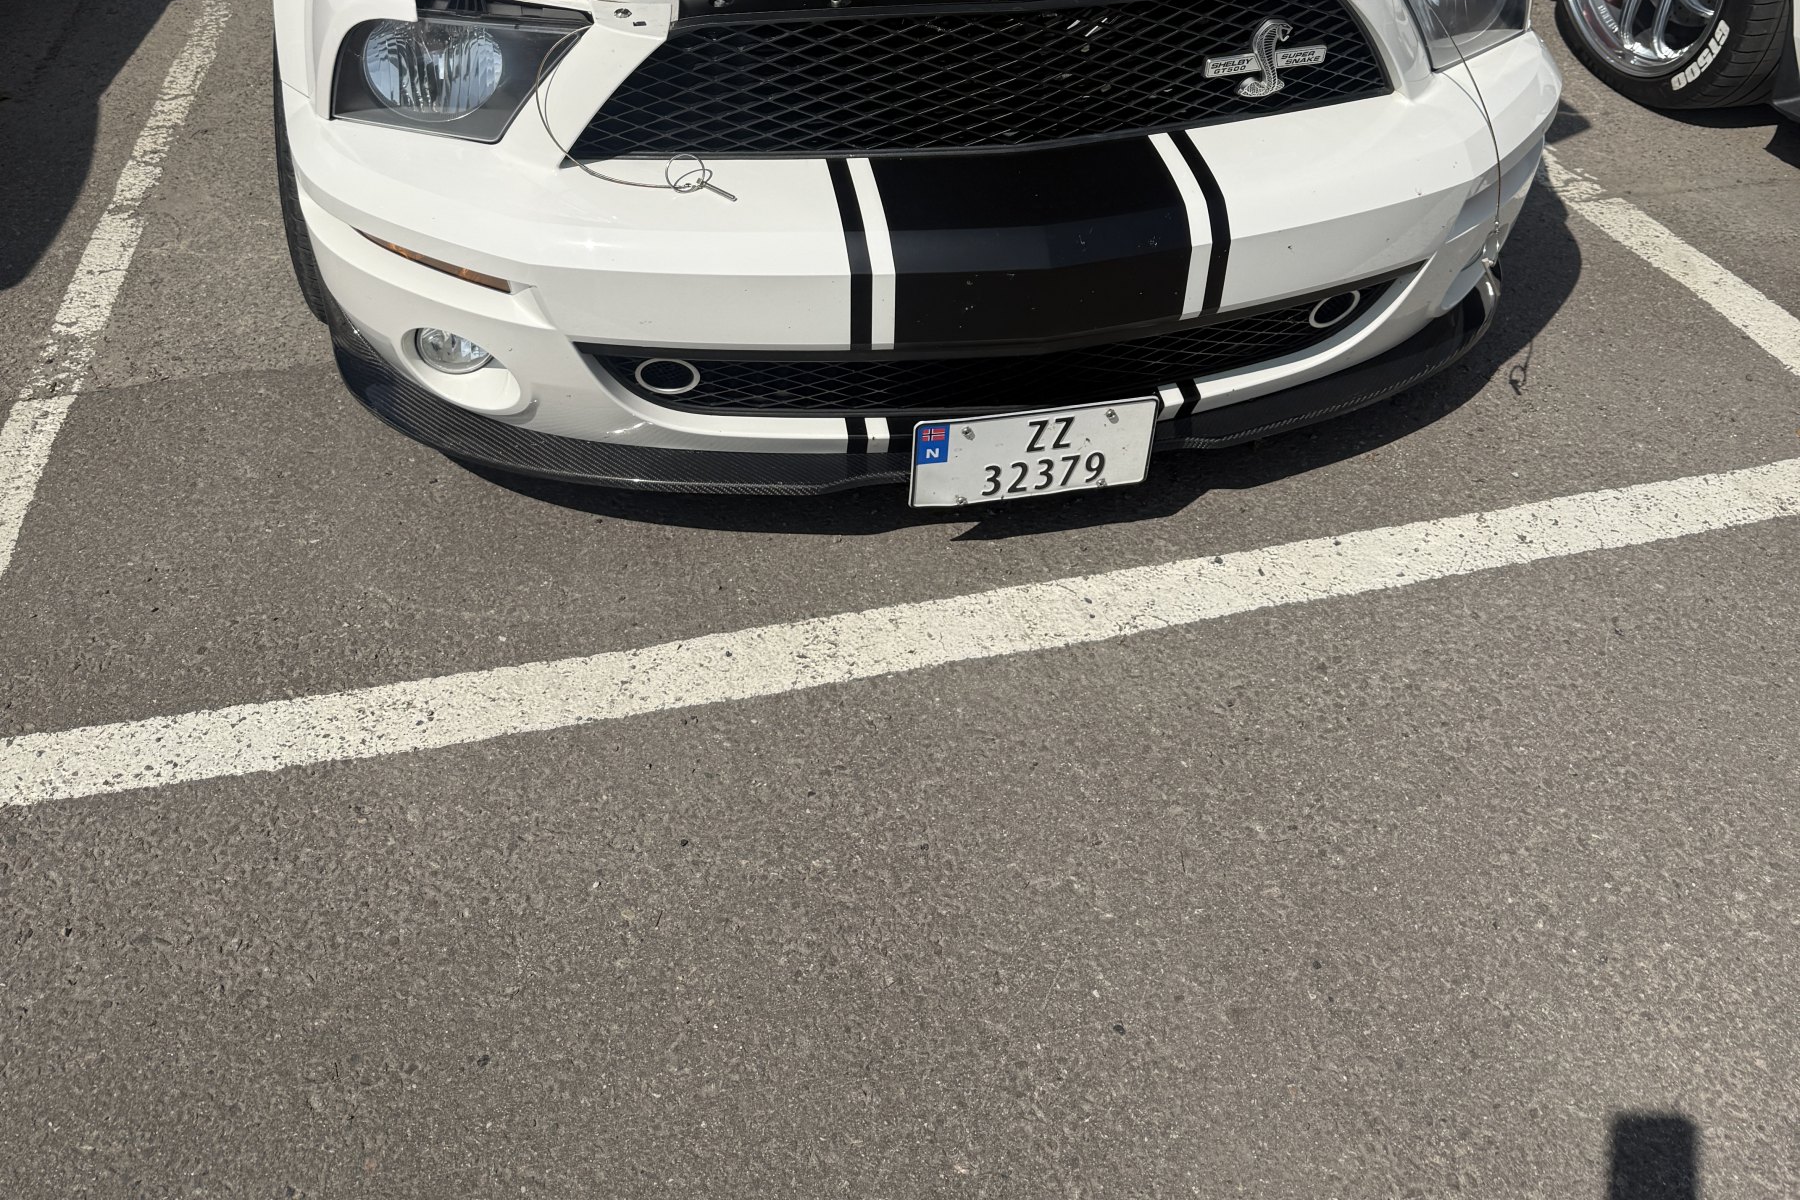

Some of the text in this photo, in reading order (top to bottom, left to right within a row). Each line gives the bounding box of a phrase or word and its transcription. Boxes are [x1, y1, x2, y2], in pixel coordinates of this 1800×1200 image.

[1281, 50, 1316, 60] SUPER
[1284, 55, 1322, 65] SNAKE
[1671, 19, 1730, 91] GT500
[1211, 57, 1252, 70] SHELBY
[1213, 64, 1247, 75] GT500
[1025, 416, 1075, 452] ZZ
[926, 447, 940, 459] N
[981, 451, 1106, 497] 32379
